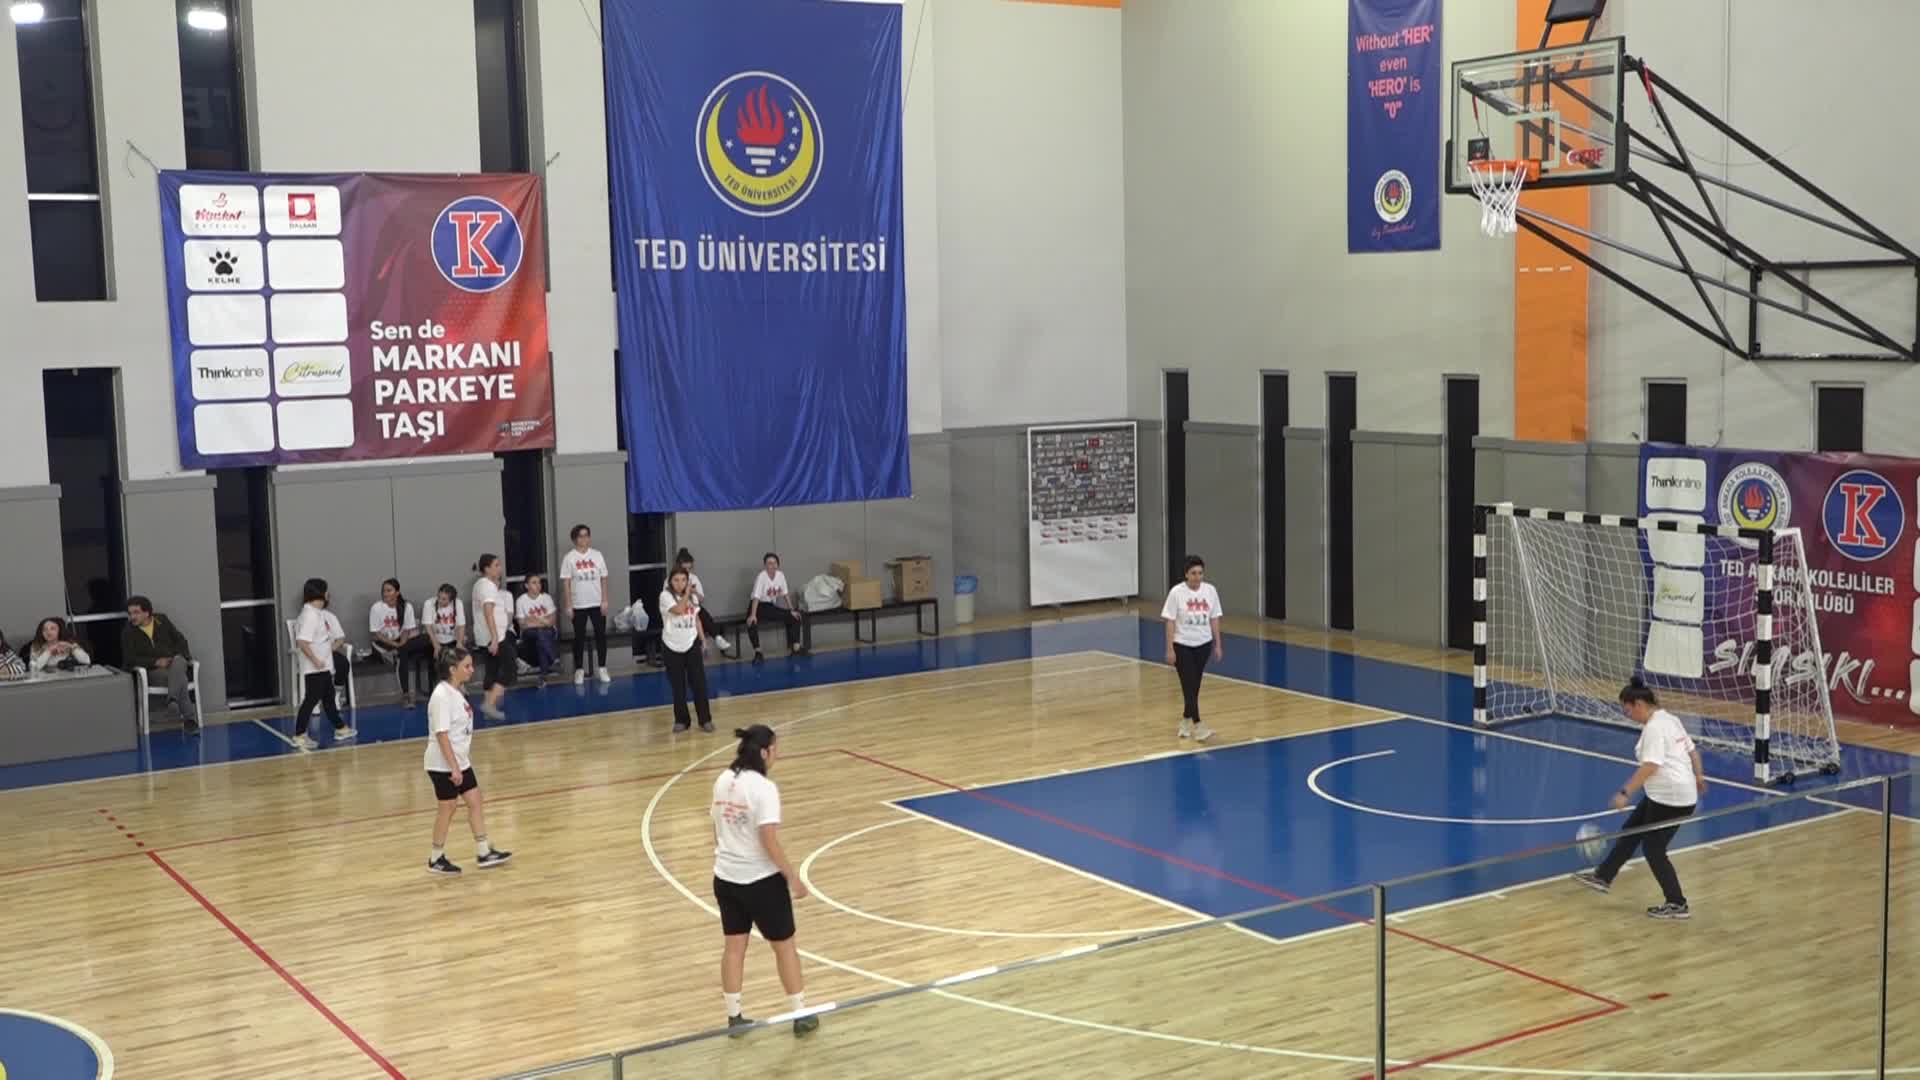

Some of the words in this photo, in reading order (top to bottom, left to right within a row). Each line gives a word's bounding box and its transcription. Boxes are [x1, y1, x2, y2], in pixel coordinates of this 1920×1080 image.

[1356, 32, 1399, 53] Without
[1379, 57, 1407, 72] even
[1409, 76, 1421, 92] is
[724, 175, 740, 190] TED
[448, 211, 506, 277] K
[634, 239, 687, 271] TED
[697, 234, 887, 272] ÜNİVERSİTESİ
[370, 320, 412, 340] Sen
[418, 319, 445, 339] de
[197, 365, 264, 379] Thinkonline
[372, 341, 521, 372] MARKANI
[375, 373, 516, 405] PARKEYE
[376, 410, 445, 443] TAŞI
[1838, 483, 1886, 548] K
[1720, 559, 1744, 577] TED
[1748, 565, 1802, 582] AKARA
[1808, 569, 1895, 595] KOLEJLİLER
